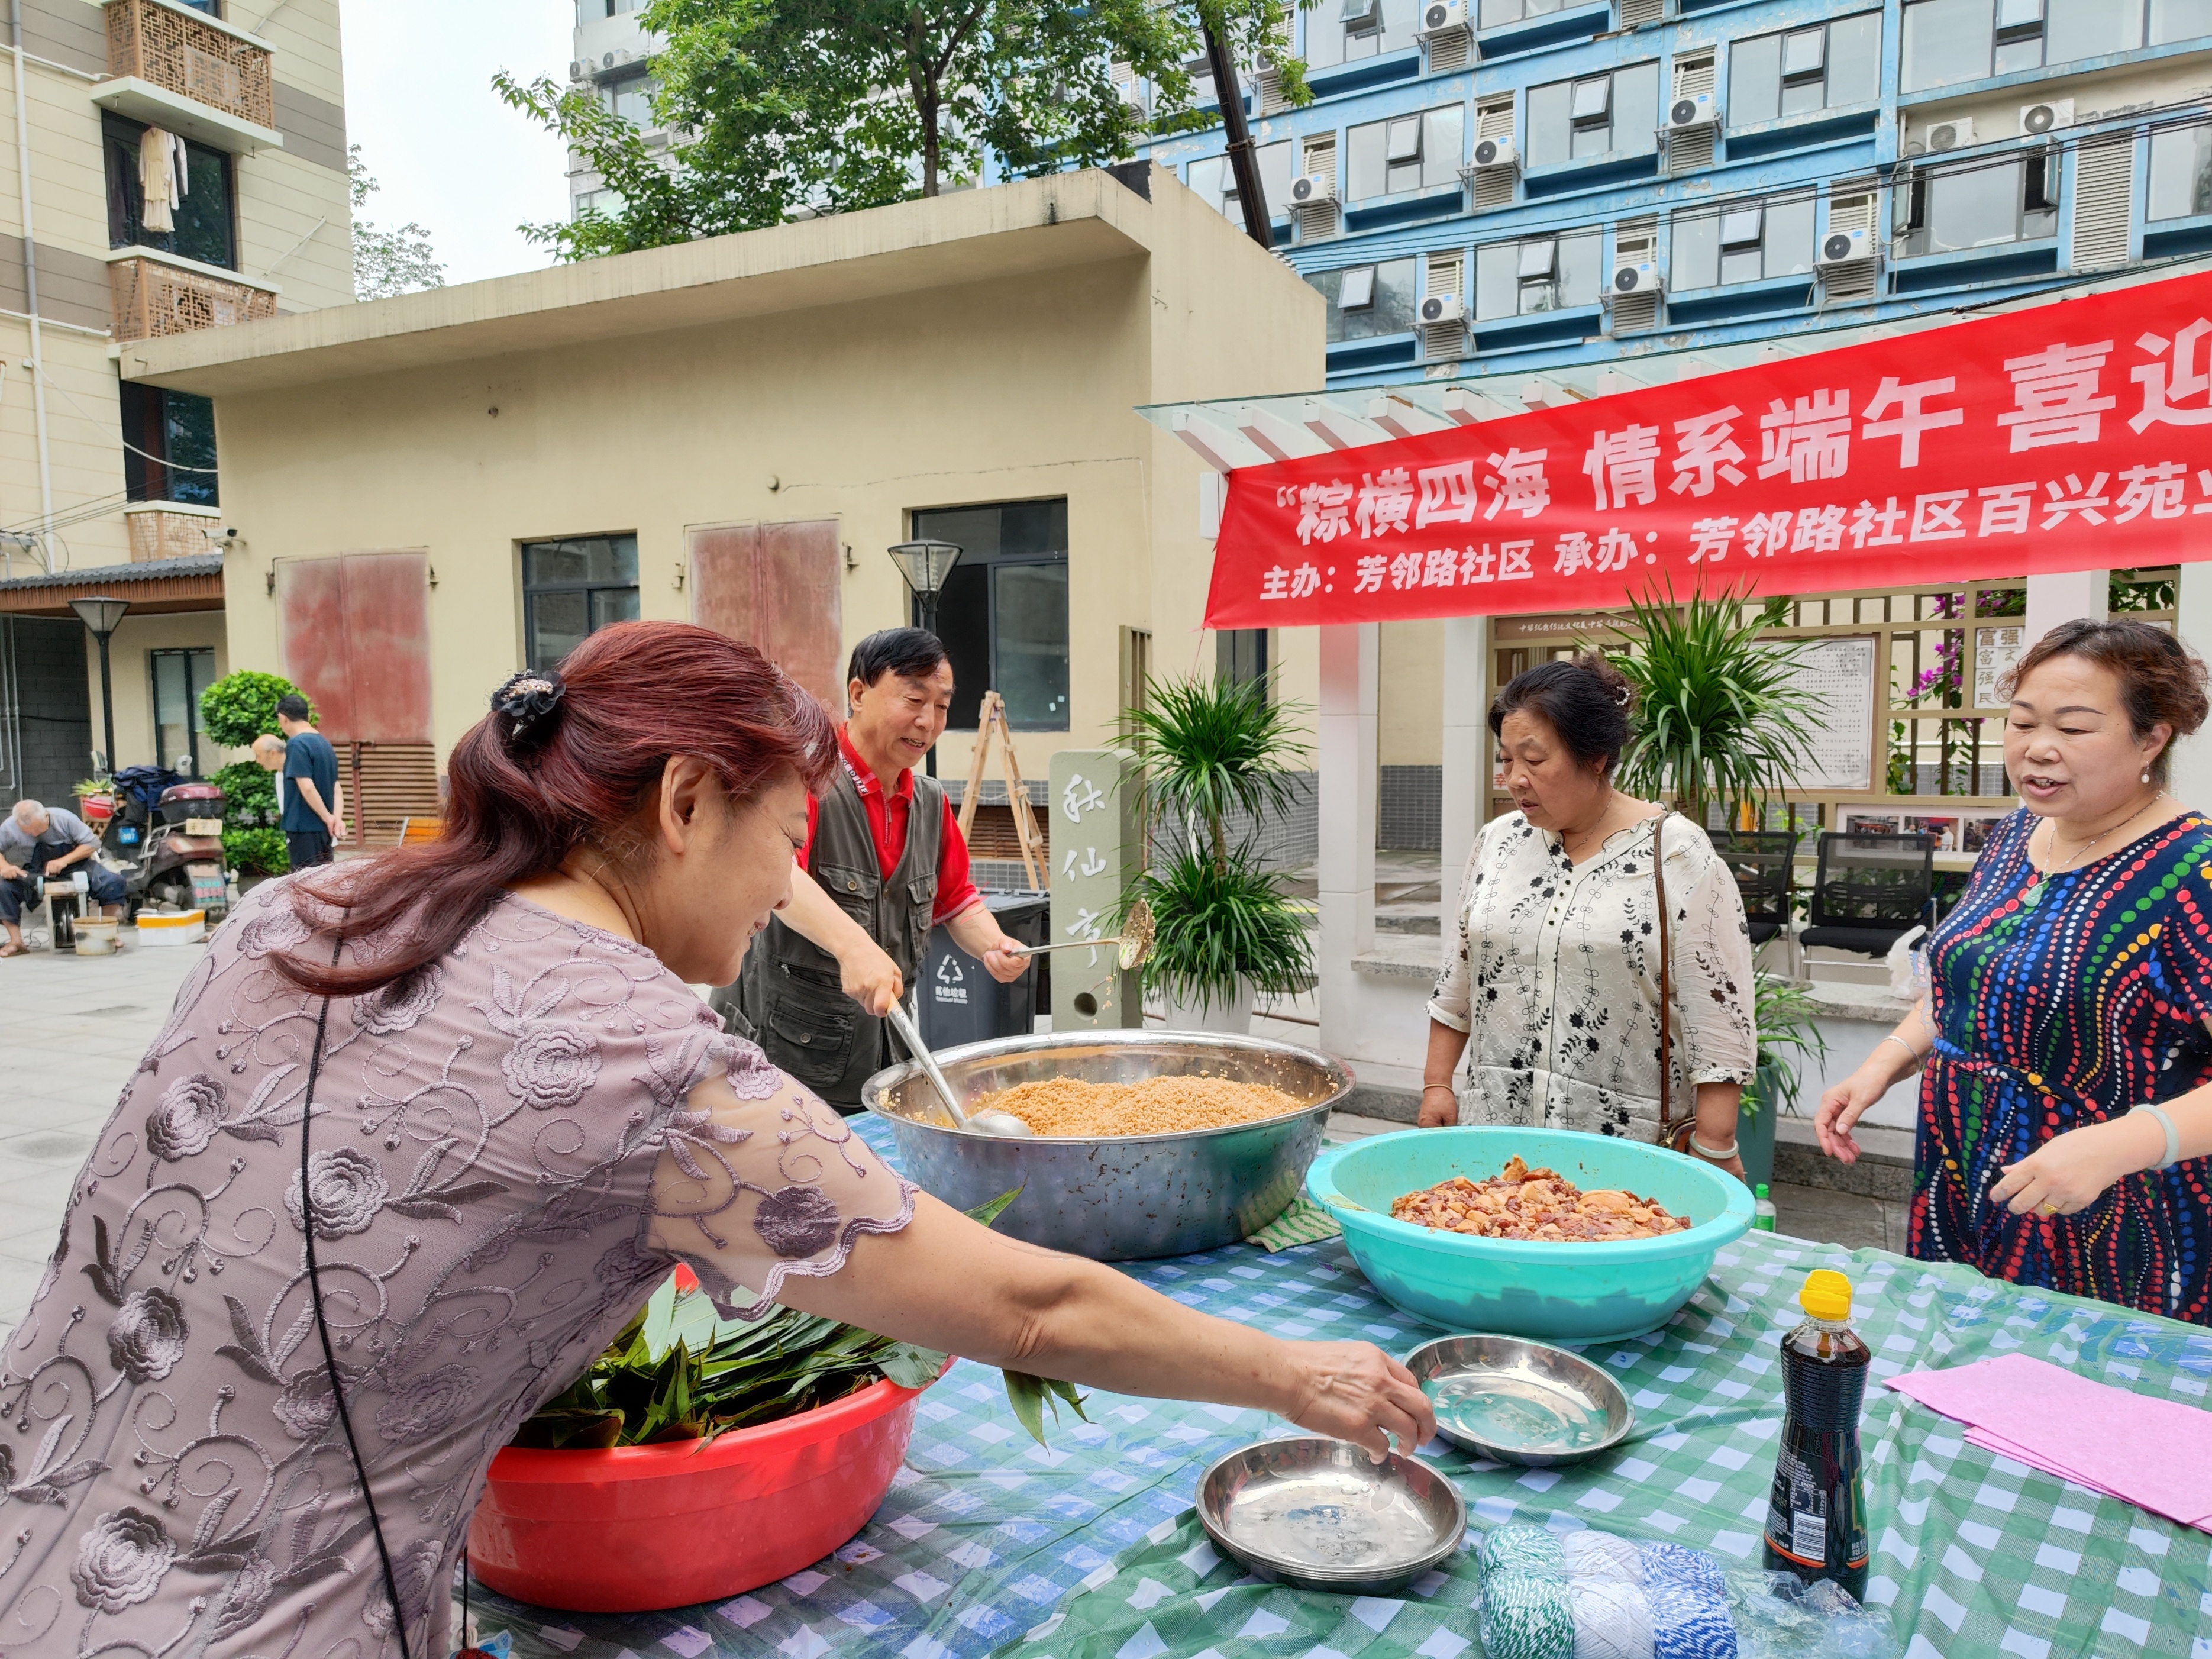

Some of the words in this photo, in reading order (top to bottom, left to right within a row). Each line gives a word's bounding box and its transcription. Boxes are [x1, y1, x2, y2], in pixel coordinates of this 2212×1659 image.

[1276, 447, 1551, 545] “粽横四海
[1582, 376, 1964, 511] 情系端午
[1997, 317, 2212, 454] 喜迎
[1552, 461, 2212, 576] 承办：芳邻路社区百兴苑
[1979, 629, 2019, 647] 富强
